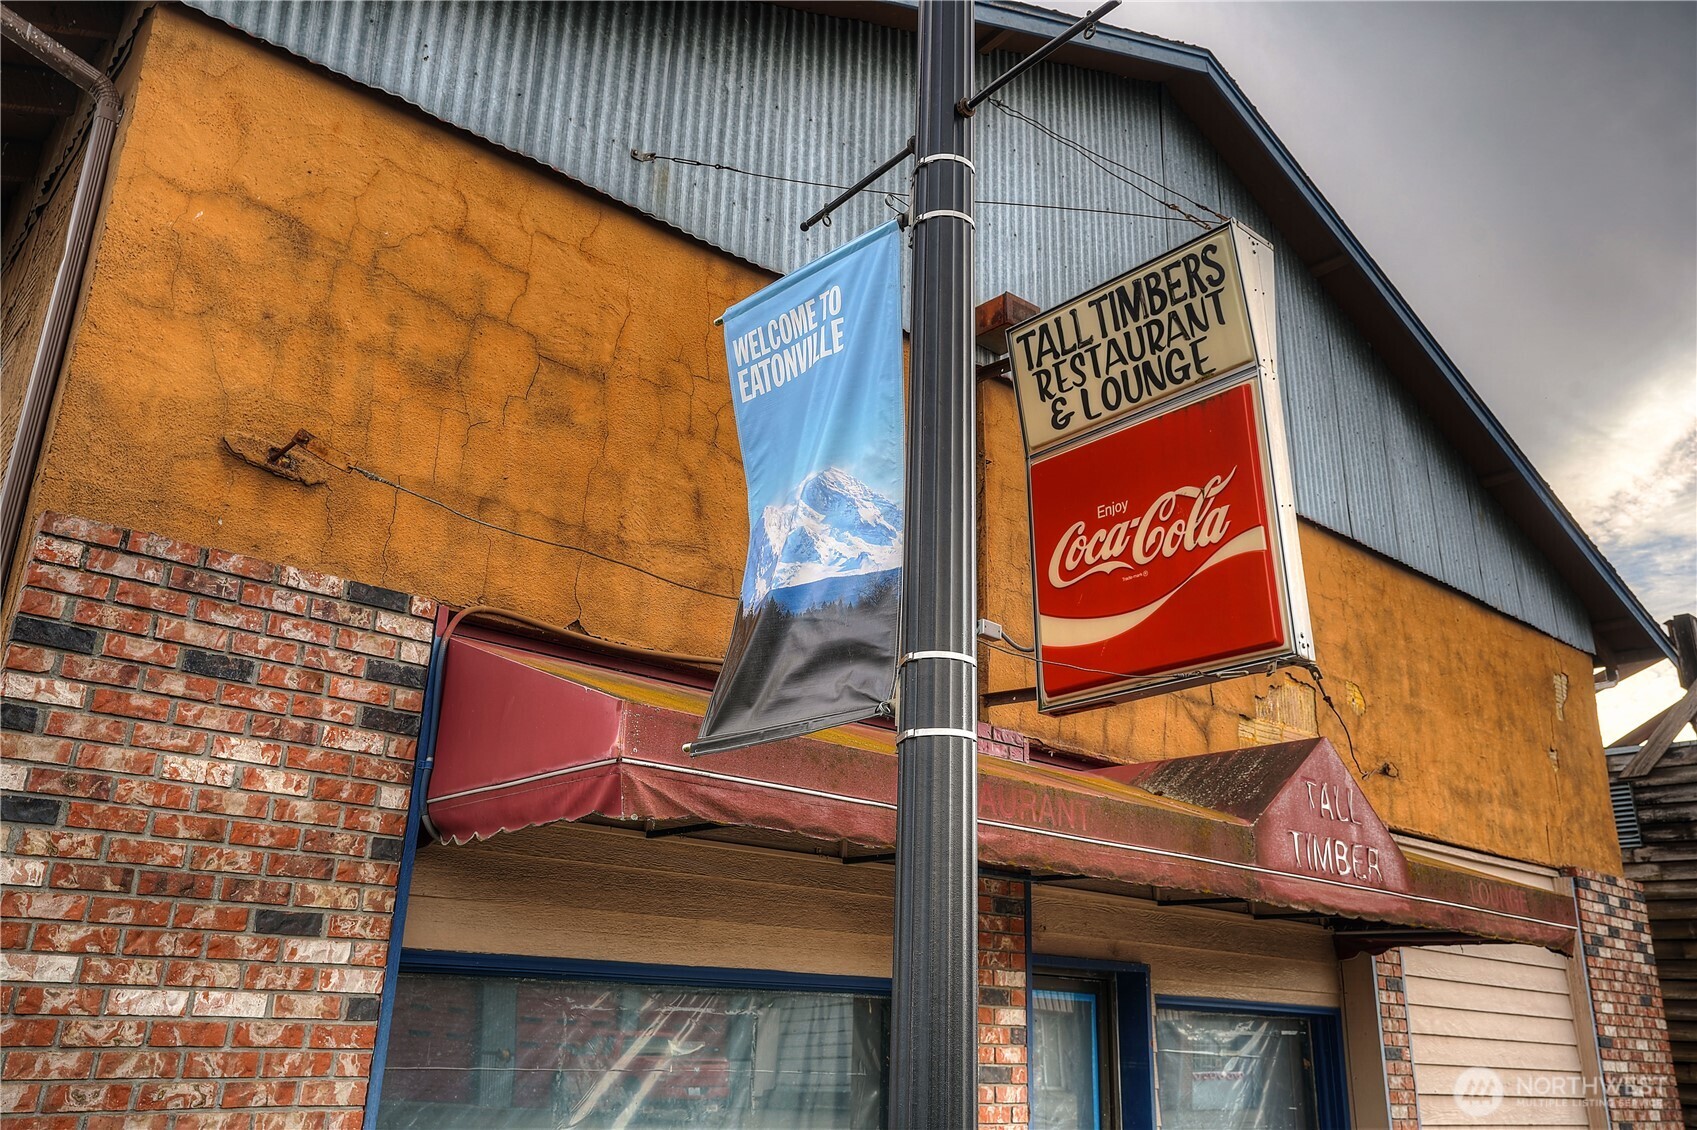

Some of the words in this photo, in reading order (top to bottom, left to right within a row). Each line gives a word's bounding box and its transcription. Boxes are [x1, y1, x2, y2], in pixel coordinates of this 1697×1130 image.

[732, 298, 818, 367] WELCOME
[819, 285, 842, 321] TO
[1016, 308, 1093, 371] TALL
[1088, 243, 1226, 338] TIMBERS
[1032, 286, 1226, 402] RESTAURANT
[737, 317, 844, 403] EATONVILLE
[1050, 396, 1075, 430] &
[1080, 336, 1217, 421] LOUNGE
[1048, 465, 1237, 589] Coca-Cola
[1097, 499, 1128, 519] Enjoy
[977, 782, 1091, 831] AURANT
[1304, 780, 1362, 825] TALL
[1288, 829, 1383, 883] TIMBER
